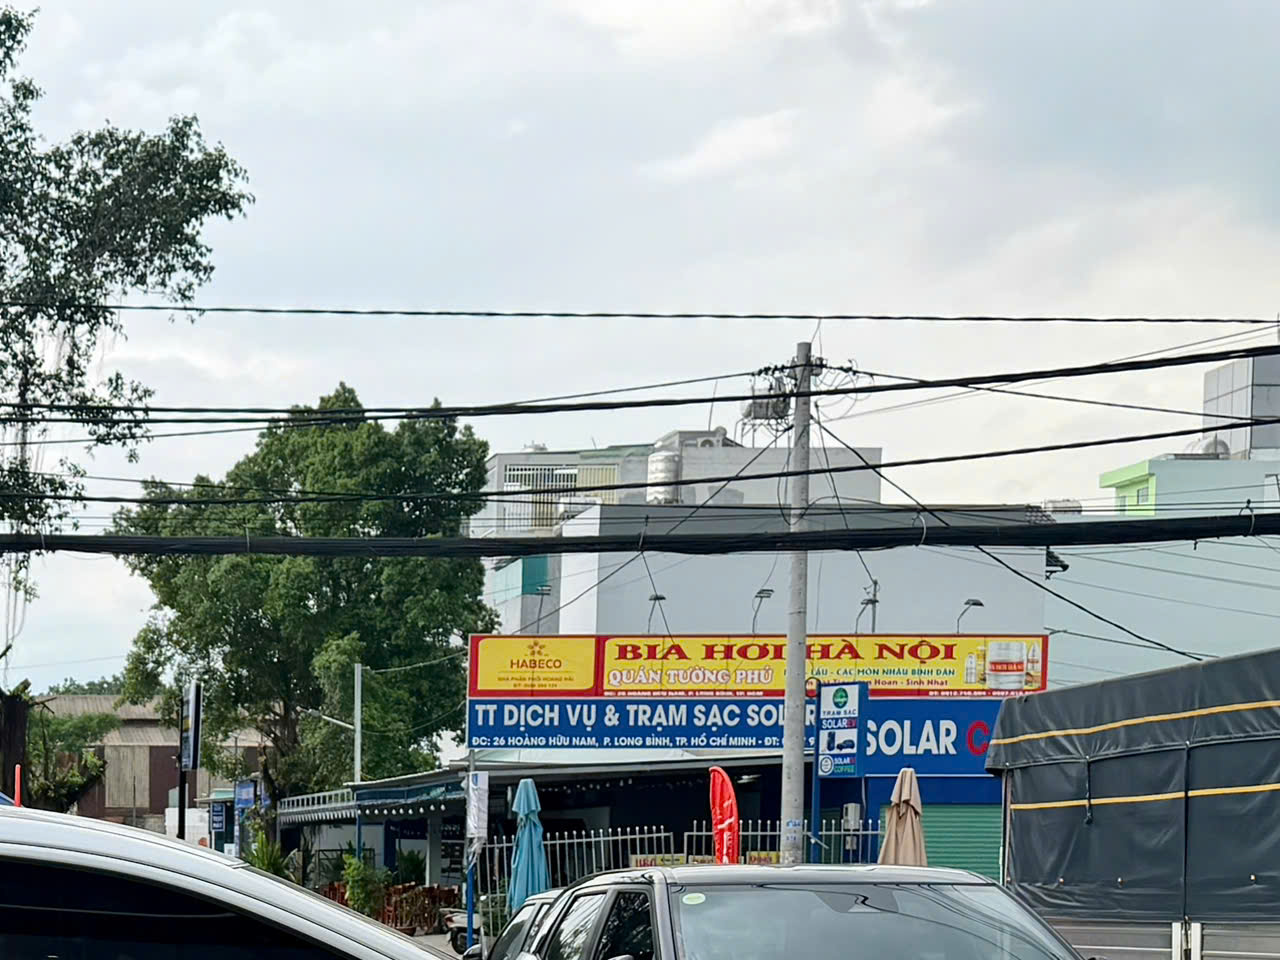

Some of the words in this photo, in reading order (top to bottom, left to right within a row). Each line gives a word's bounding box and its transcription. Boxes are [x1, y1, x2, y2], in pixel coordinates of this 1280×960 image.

[614, 643, 691, 660] BIA
[701, 643, 786, 660] HƠI
[874, 640, 957, 664] NỘI
[510, 659, 562, 669] HABECO
[936, 667, 955, 676] DÂN
[608, 665, 661, 686] QUÁN
[667, 665, 730, 684] TƯỜNG
[735, 665, 773, 684] PHÚ
[475, 704, 497, 726] TT
[504, 704, 559, 731] DỊCH
[566, 704, 596, 731] VỤ
[604, 705, 620, 726] &
[626, 704, 687, 731] TRẠM
[693, 704, 741, 731] SẠC
[472, 737, 490, 746] ĐC:
[493, 737, 505, 746] 26
[508, 734, 546, 746] HOÀNG
[549, 734, 570, 746] HỮU
[572, 737, 598, 747] NAM,
[603, 737, 611, 746] P.
[614, 737, 643, 746] LONG
[646, 734, 672, 747] BÌNH,
[675, 737, 688, 746] TP.
[709, 734, 727, 746] CHÍ
[729, 737, 756, 746] MINH
[764, 737, 779, 746] ĐT:
[866, 719, 957, 755] SOLAR
